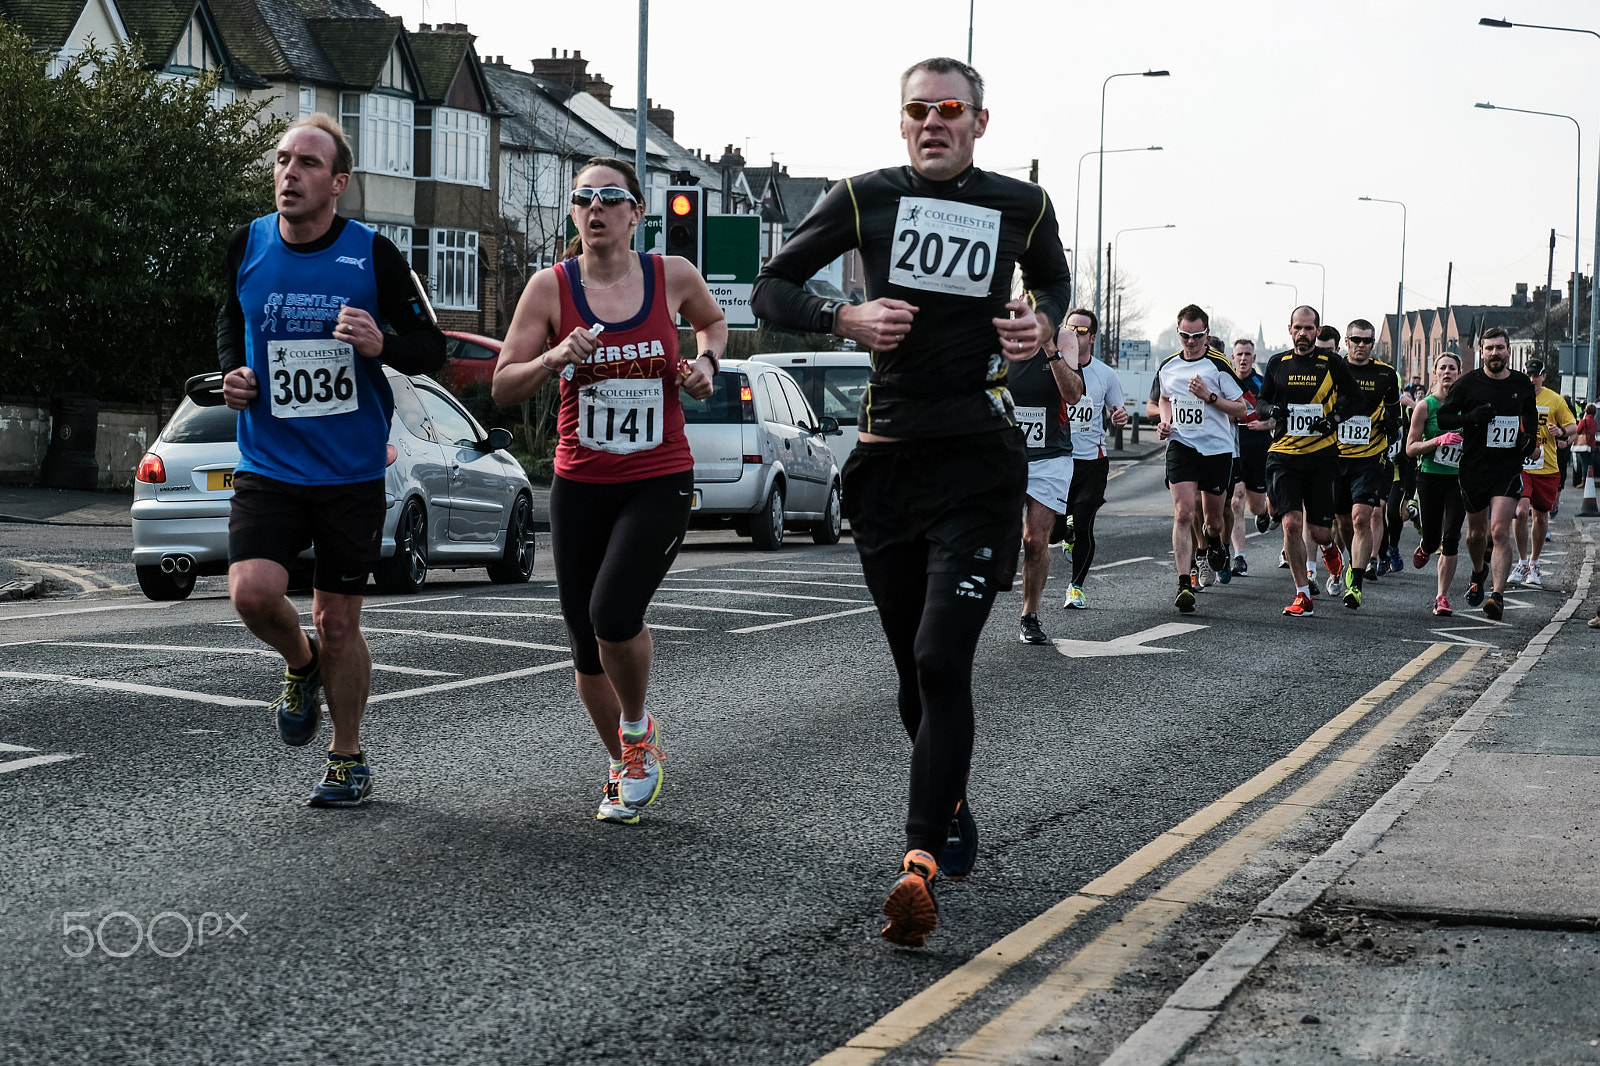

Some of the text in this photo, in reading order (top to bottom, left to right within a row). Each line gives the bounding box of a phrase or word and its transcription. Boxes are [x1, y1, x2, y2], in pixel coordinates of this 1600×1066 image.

[924, 209, 995, 230] COLCHESTER
[895, 229, 990, 282] 2070
[285, 293, 350, 308] BENTLEY
[286, 319, 323, 333] CLUB
[289, 347, 351, 359] COLCHESTER
[273, 366, 354, 406] 3036
[599, 388, 660, 397] COLCHESTER
[1069, 405, 1093, 422] 240
[1175, 407, 1203, 424] 1058
[587, 404, 654, 442] 1141
[1341, 425, 1370, 440] 1182
[1492, 427, 1516, 442] 212
[1441, 445, 1464, 463] 917
[223, 473, 233, 488] R
